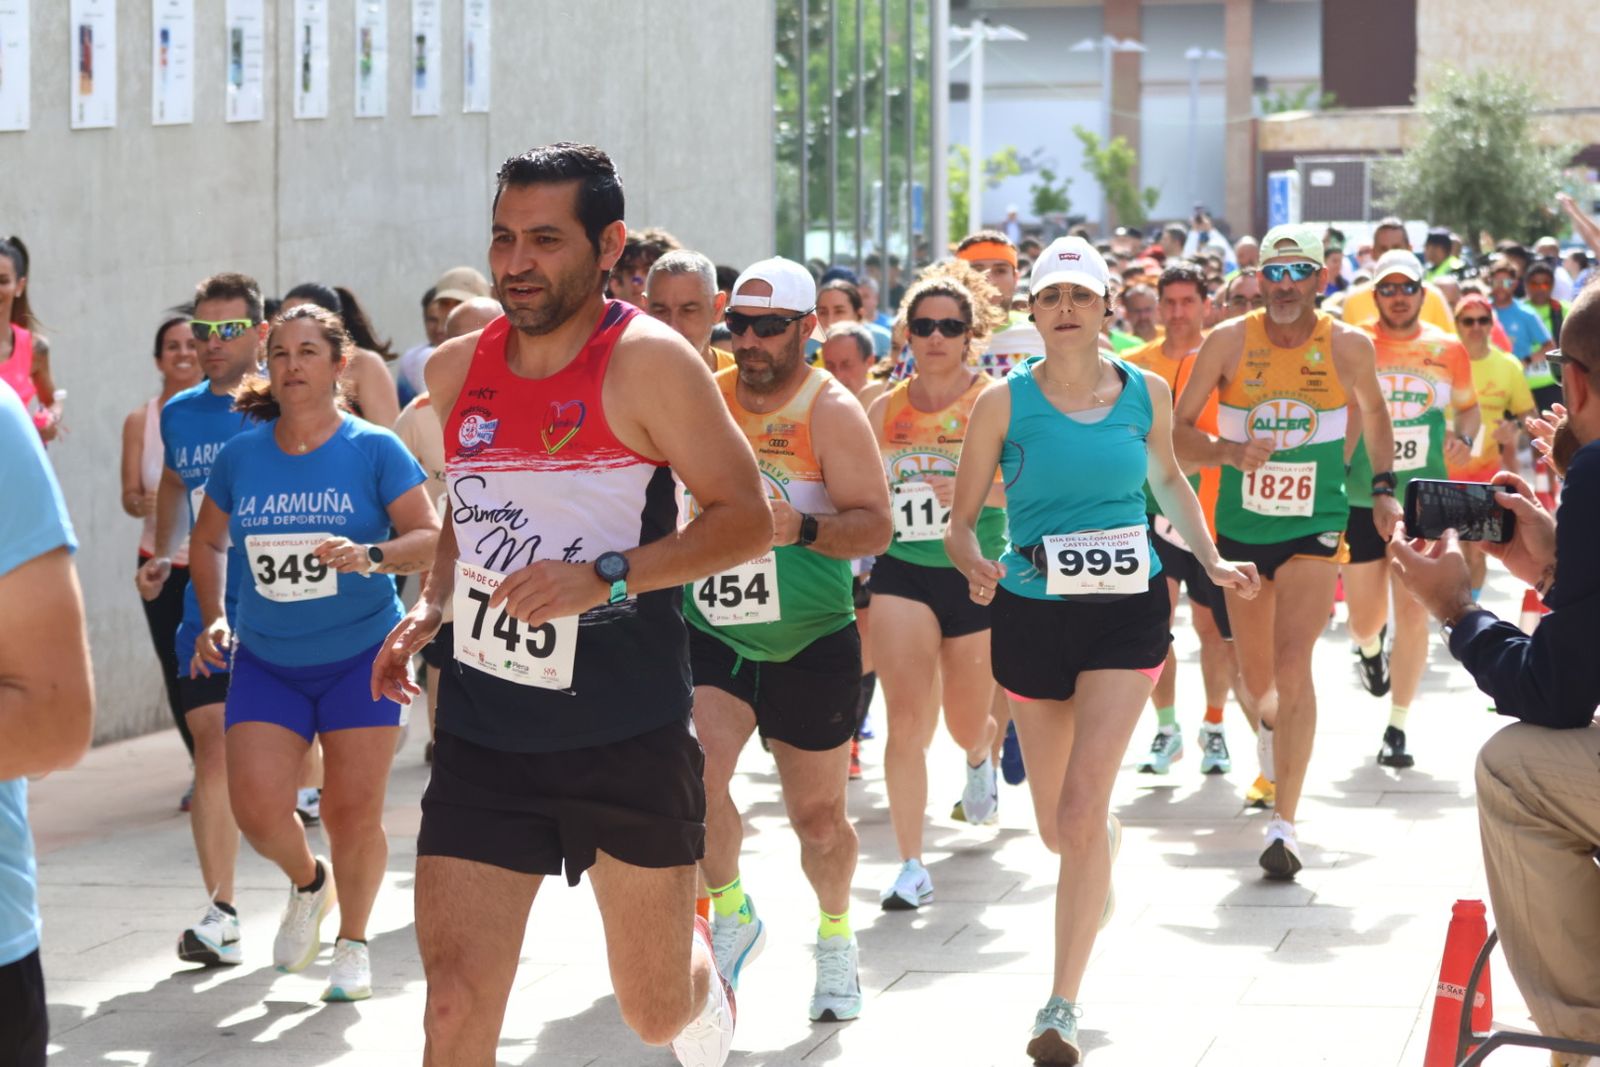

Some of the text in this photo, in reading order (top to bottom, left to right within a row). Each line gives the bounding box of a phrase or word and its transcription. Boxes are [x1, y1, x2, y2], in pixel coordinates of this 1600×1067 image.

[1252, 417, 1311, 432] ALCER
[176, 443, 225, 468] LA ARM
[758, 460, 790, 486] RTIVO
[1246, 471, 1312, 500] 1826
[237, 488, 355, 516] LA ARMUÑA
[453, 475, 528, 530] Simón
[241, 514, 347, 528] CLUB DEPORTIVO
[1089, 531, 1141, 541] COMUNIDAD
[257, 553, 328, 585] 349
[462, 567, 476, 579] DÍA
[476, 573, 487, 585] DE
[1057, 548, 1139, 577] 995
[698, 573, 769, 608] 454
[468, 587, 556, 659] 745
